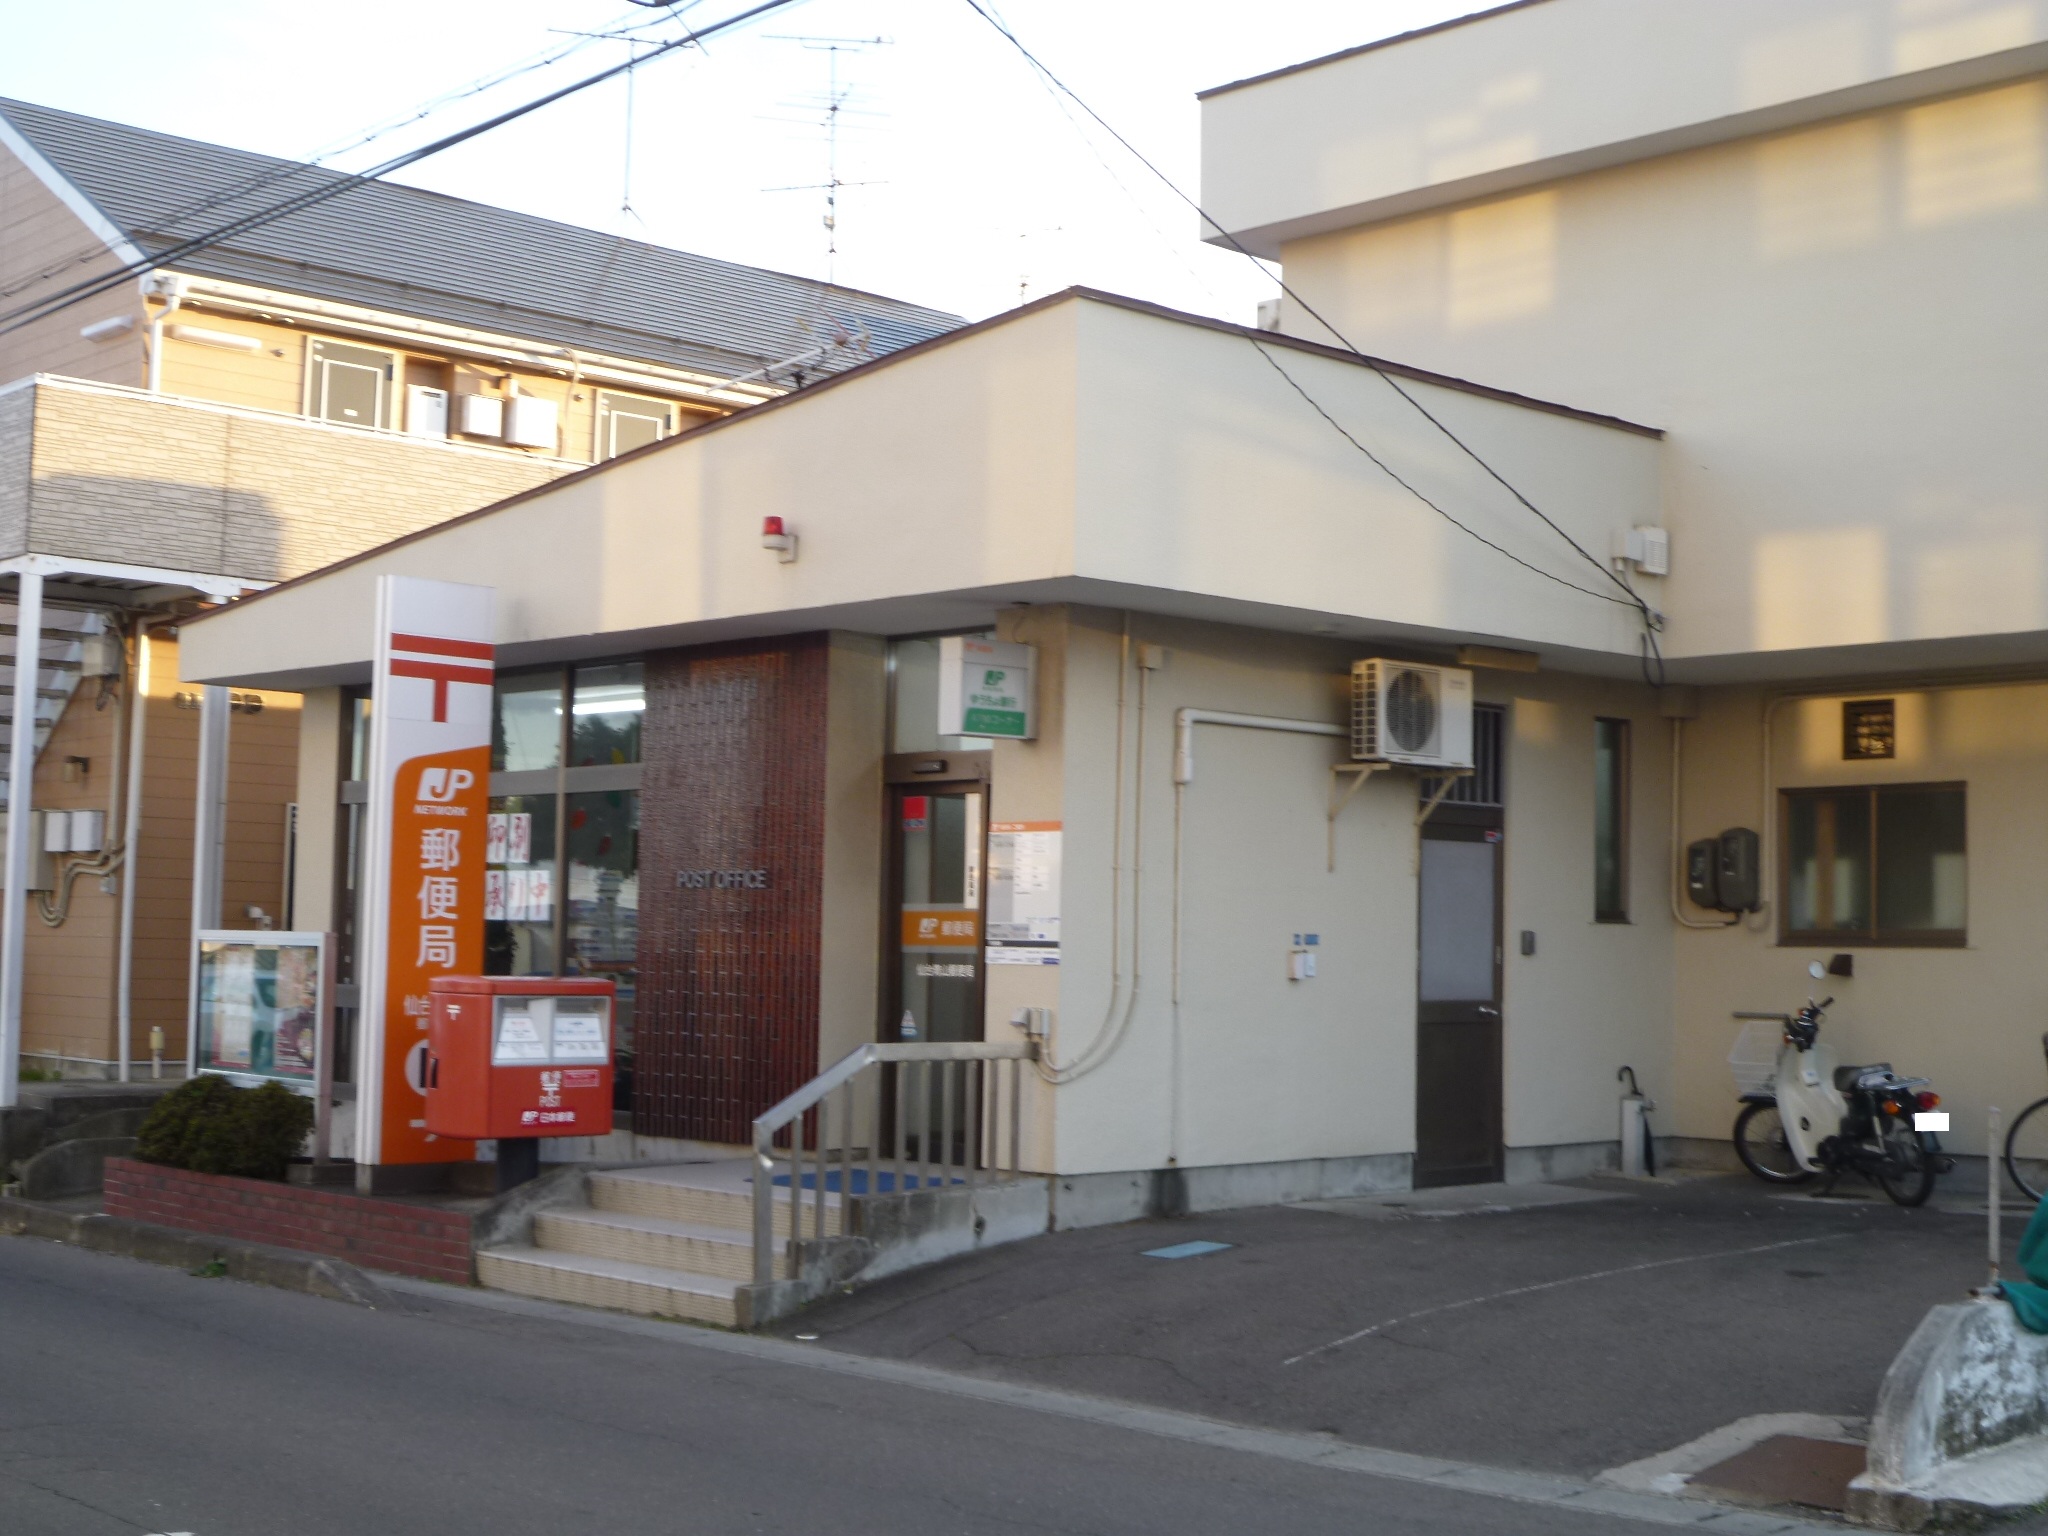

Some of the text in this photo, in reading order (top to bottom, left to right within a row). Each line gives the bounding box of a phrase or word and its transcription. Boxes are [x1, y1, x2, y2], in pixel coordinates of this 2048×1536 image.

[413, 804, 469, 817] NETWORK
[676, 870, 767, 889] POST OFFICE
[415, 828, 462, 969] 郵便局
[941, 920, 975, 937] 郵便局
[538, 1095, 561, 1108] POST
